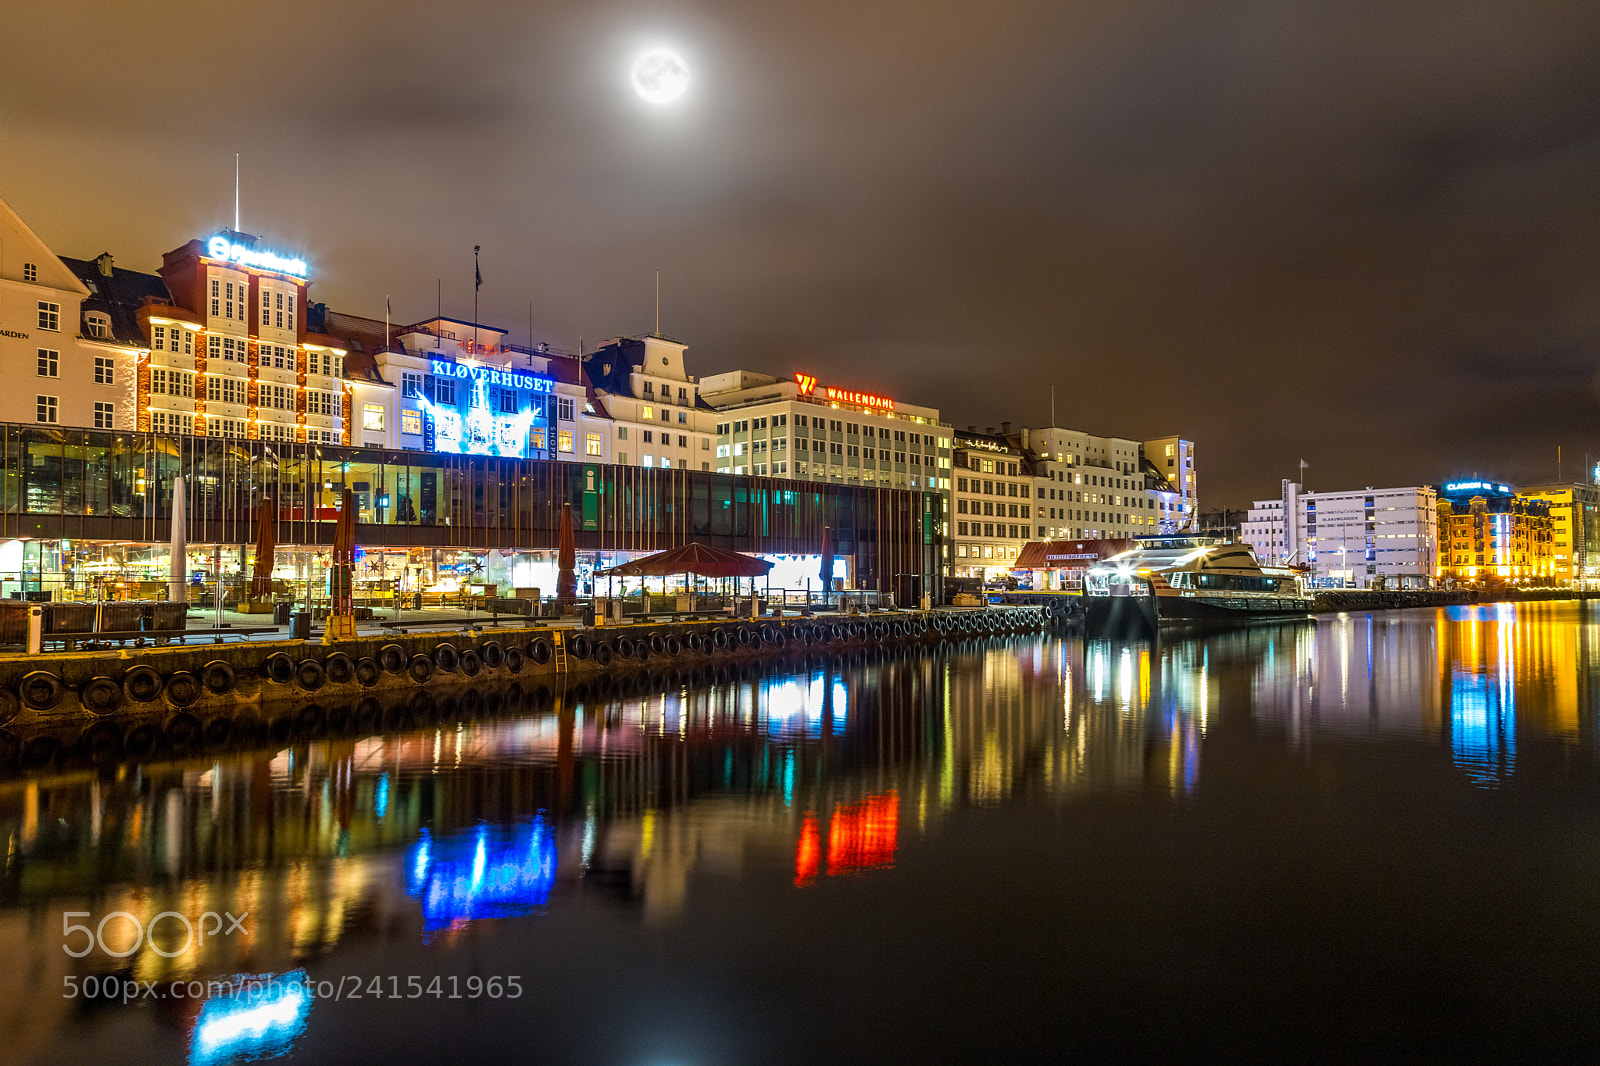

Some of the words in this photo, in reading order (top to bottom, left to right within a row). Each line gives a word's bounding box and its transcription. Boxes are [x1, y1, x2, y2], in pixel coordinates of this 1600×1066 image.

[0, 329, 29, 340] ARDEN
[432, 360, 553, 393] KLØVERHUSET
[828, 388, 894, 409] WALLENDAHL
